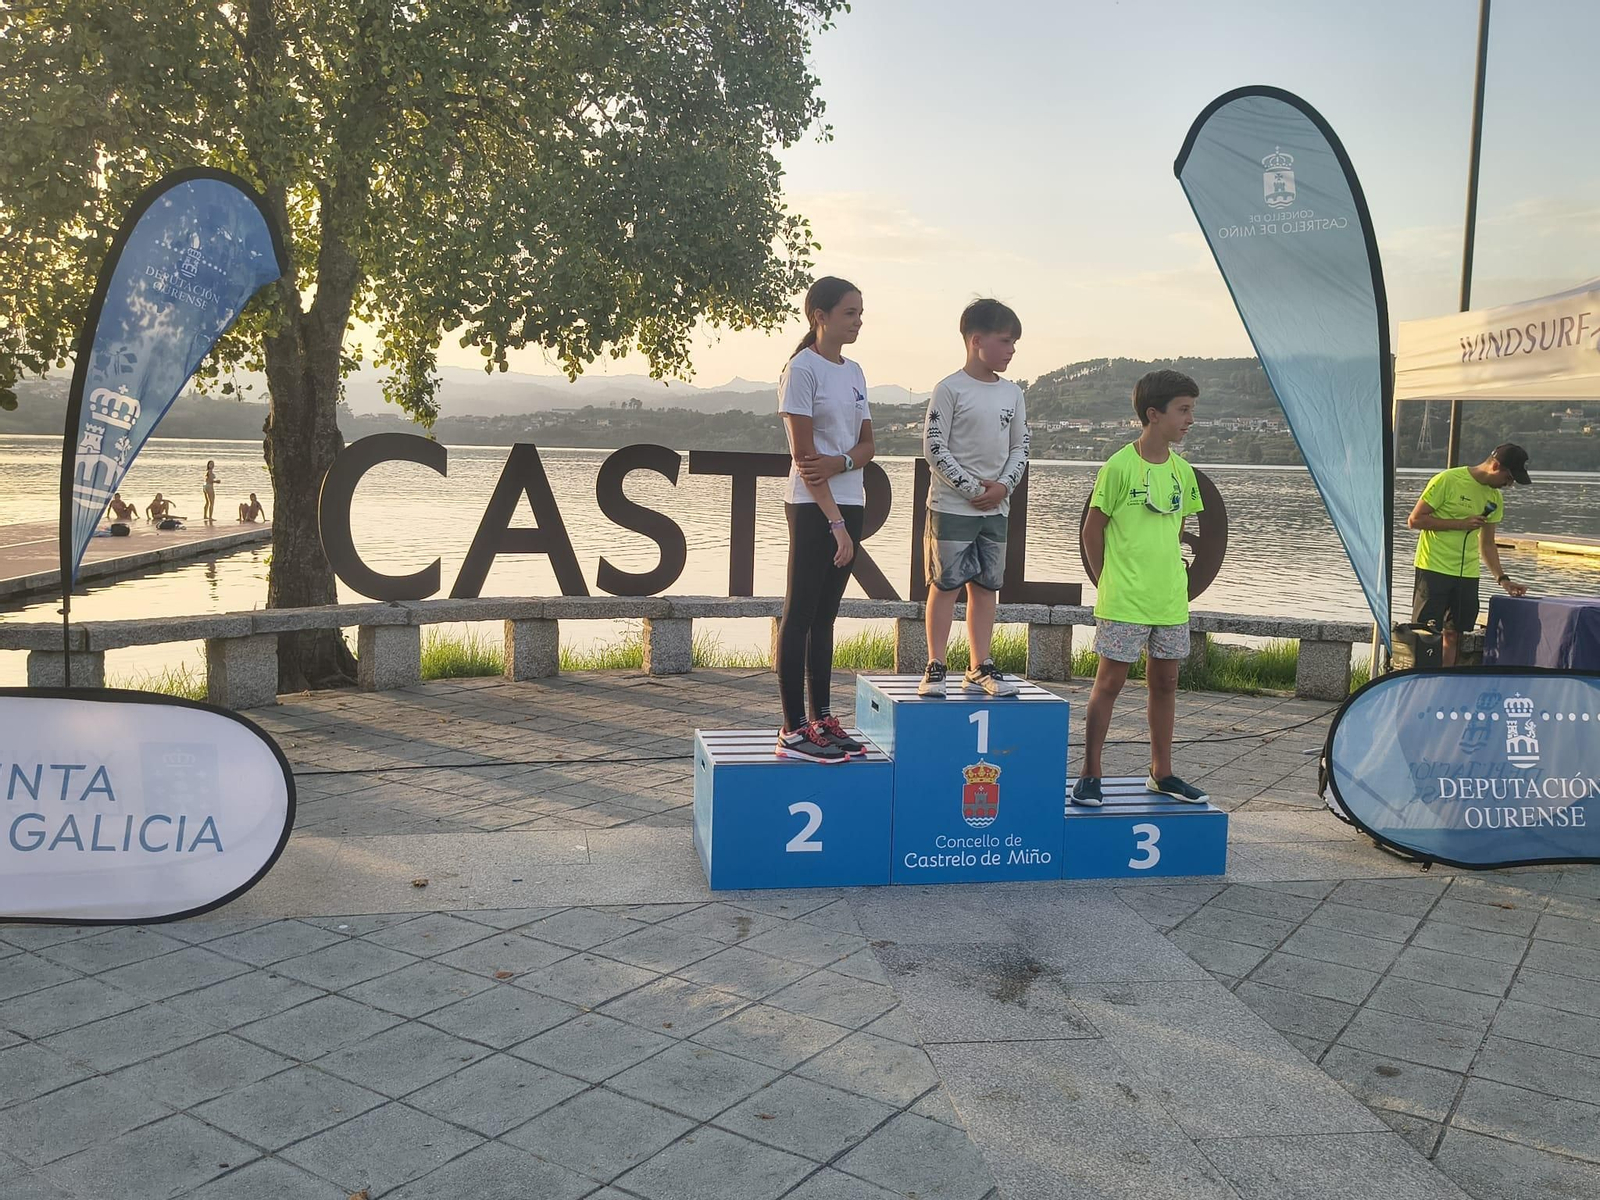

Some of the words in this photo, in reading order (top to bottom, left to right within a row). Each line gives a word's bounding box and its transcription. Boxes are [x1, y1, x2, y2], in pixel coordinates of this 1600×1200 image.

[145, 265, 220, 304] DEPUTACIÓN
[152, 281, 208, 310] OURENSE
[1459, 311, 1591, 363] WINDSURF
[968, 709, 989, 754] 1
[0, 763, 116, 801] NTA
[8, 812, 224, 853] GALICIA
[785, 801, 824, 853] 2
[1464, 806, 1587, 829] OURENSE
[904, 850, 977, 868] Castrelo
[980, 850, 1001, 866] de
[1006, 849, 1052, 865] Miño
[935, 834, 1000, 849] Concello
[1004, 833, 1022, 847] de
[1128, 823, 1161, 870] 3
